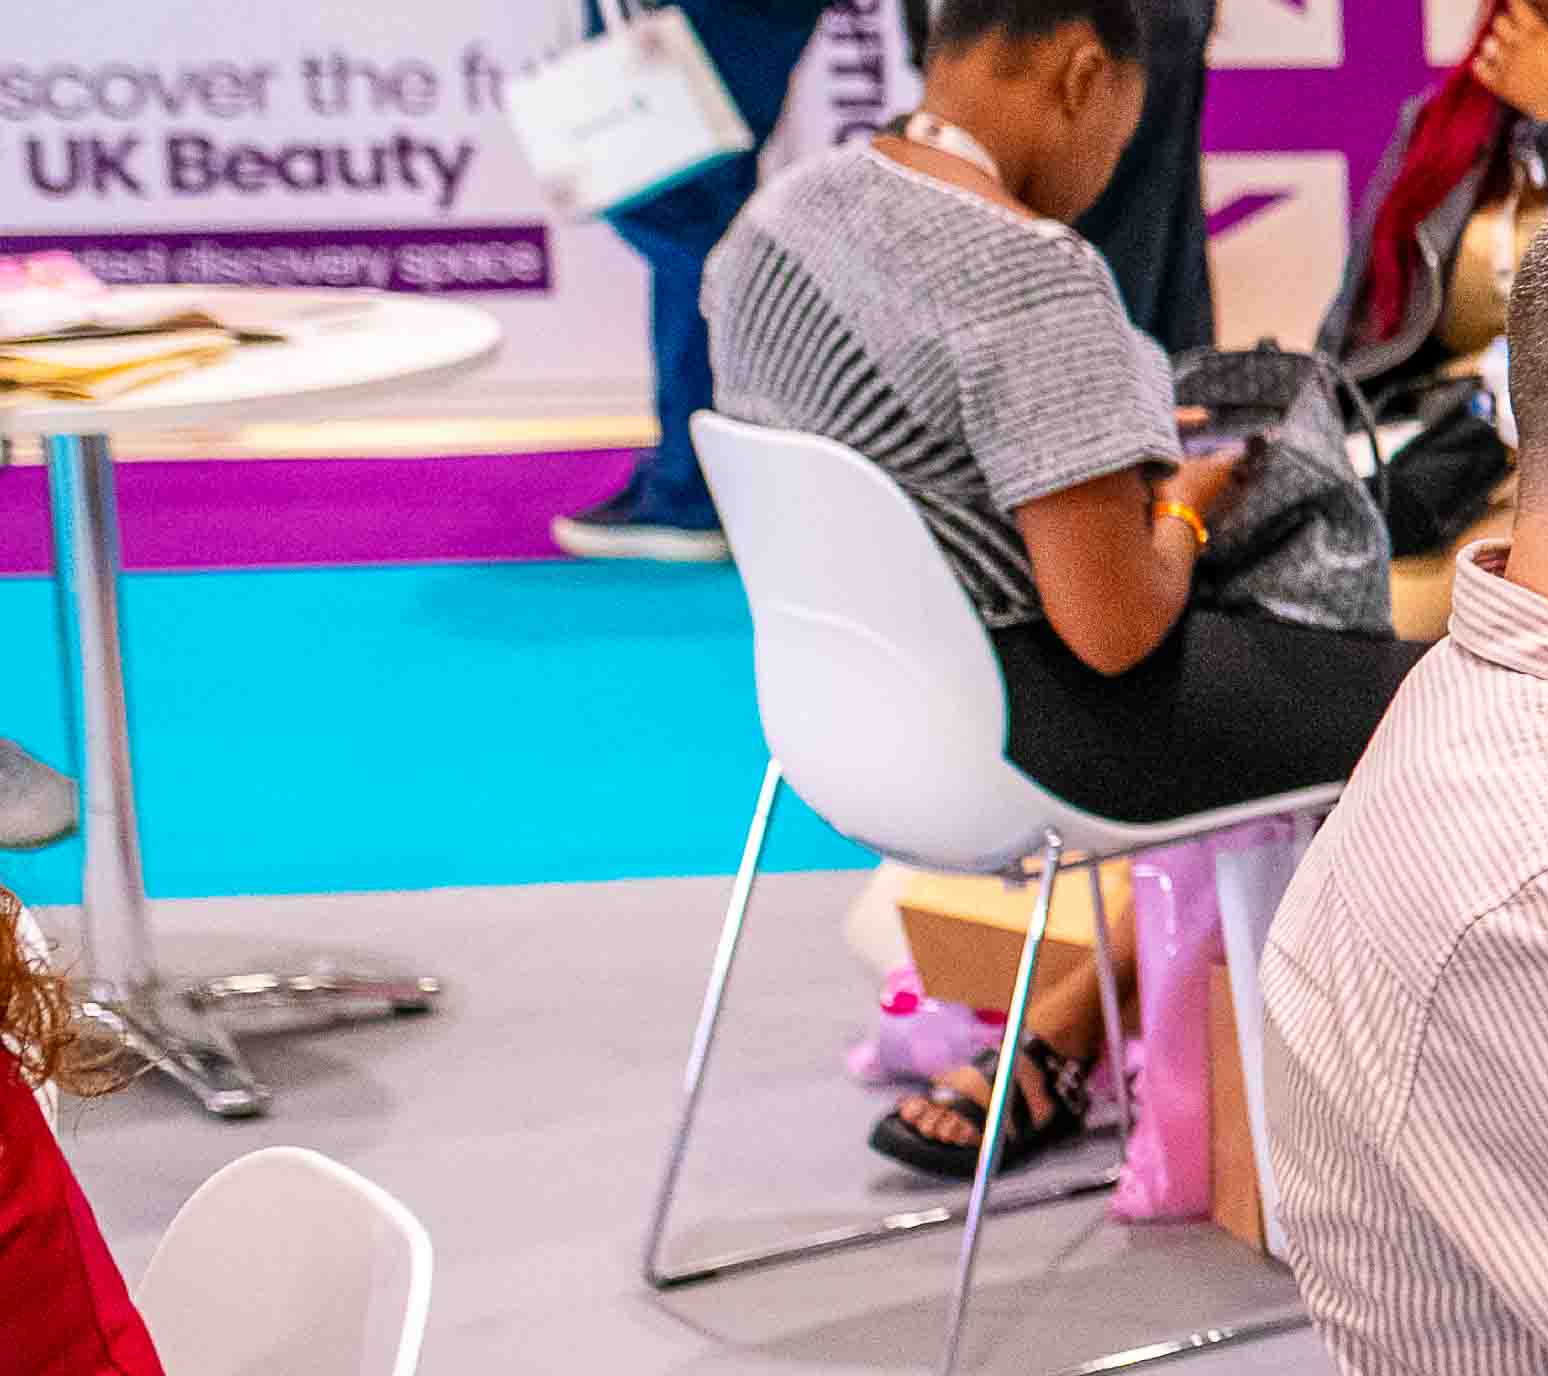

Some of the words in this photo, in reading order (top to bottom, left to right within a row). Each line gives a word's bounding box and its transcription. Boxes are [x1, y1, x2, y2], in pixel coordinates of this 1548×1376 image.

[302, 46, 438, 118] the
[25, 134, 143, 197] UK
[166, 130, 474, 208] Beauty
